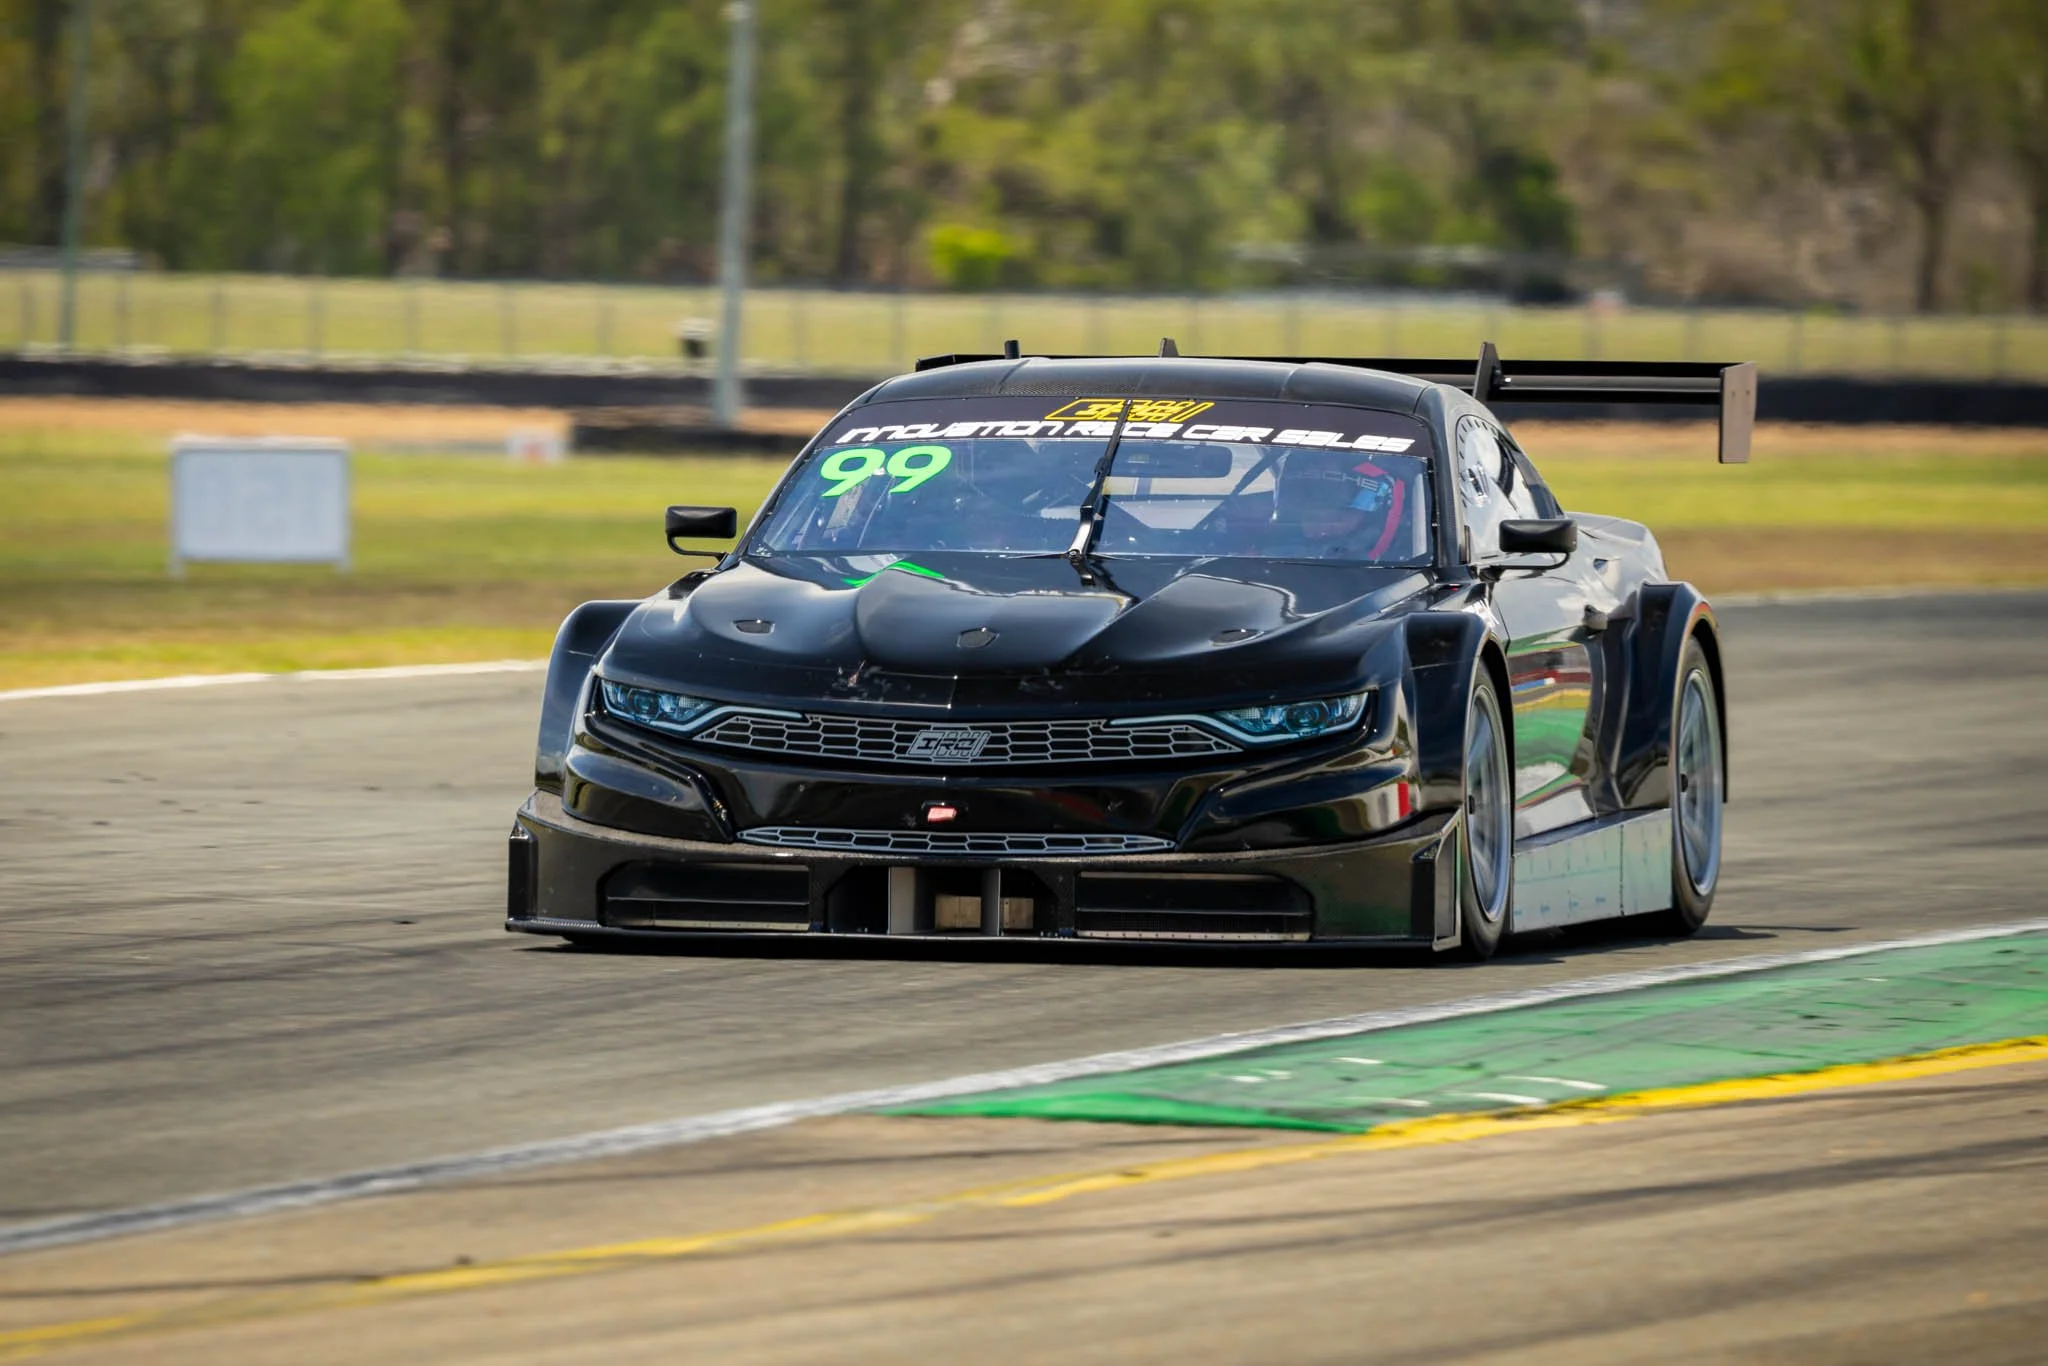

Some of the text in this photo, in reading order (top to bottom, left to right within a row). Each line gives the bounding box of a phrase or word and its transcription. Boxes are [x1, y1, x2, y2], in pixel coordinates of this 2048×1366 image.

[1182, 424, 1274, 442] CAR
[1271, 429, 1415, 452] SALES
[820, 445, 952, 497] 99
